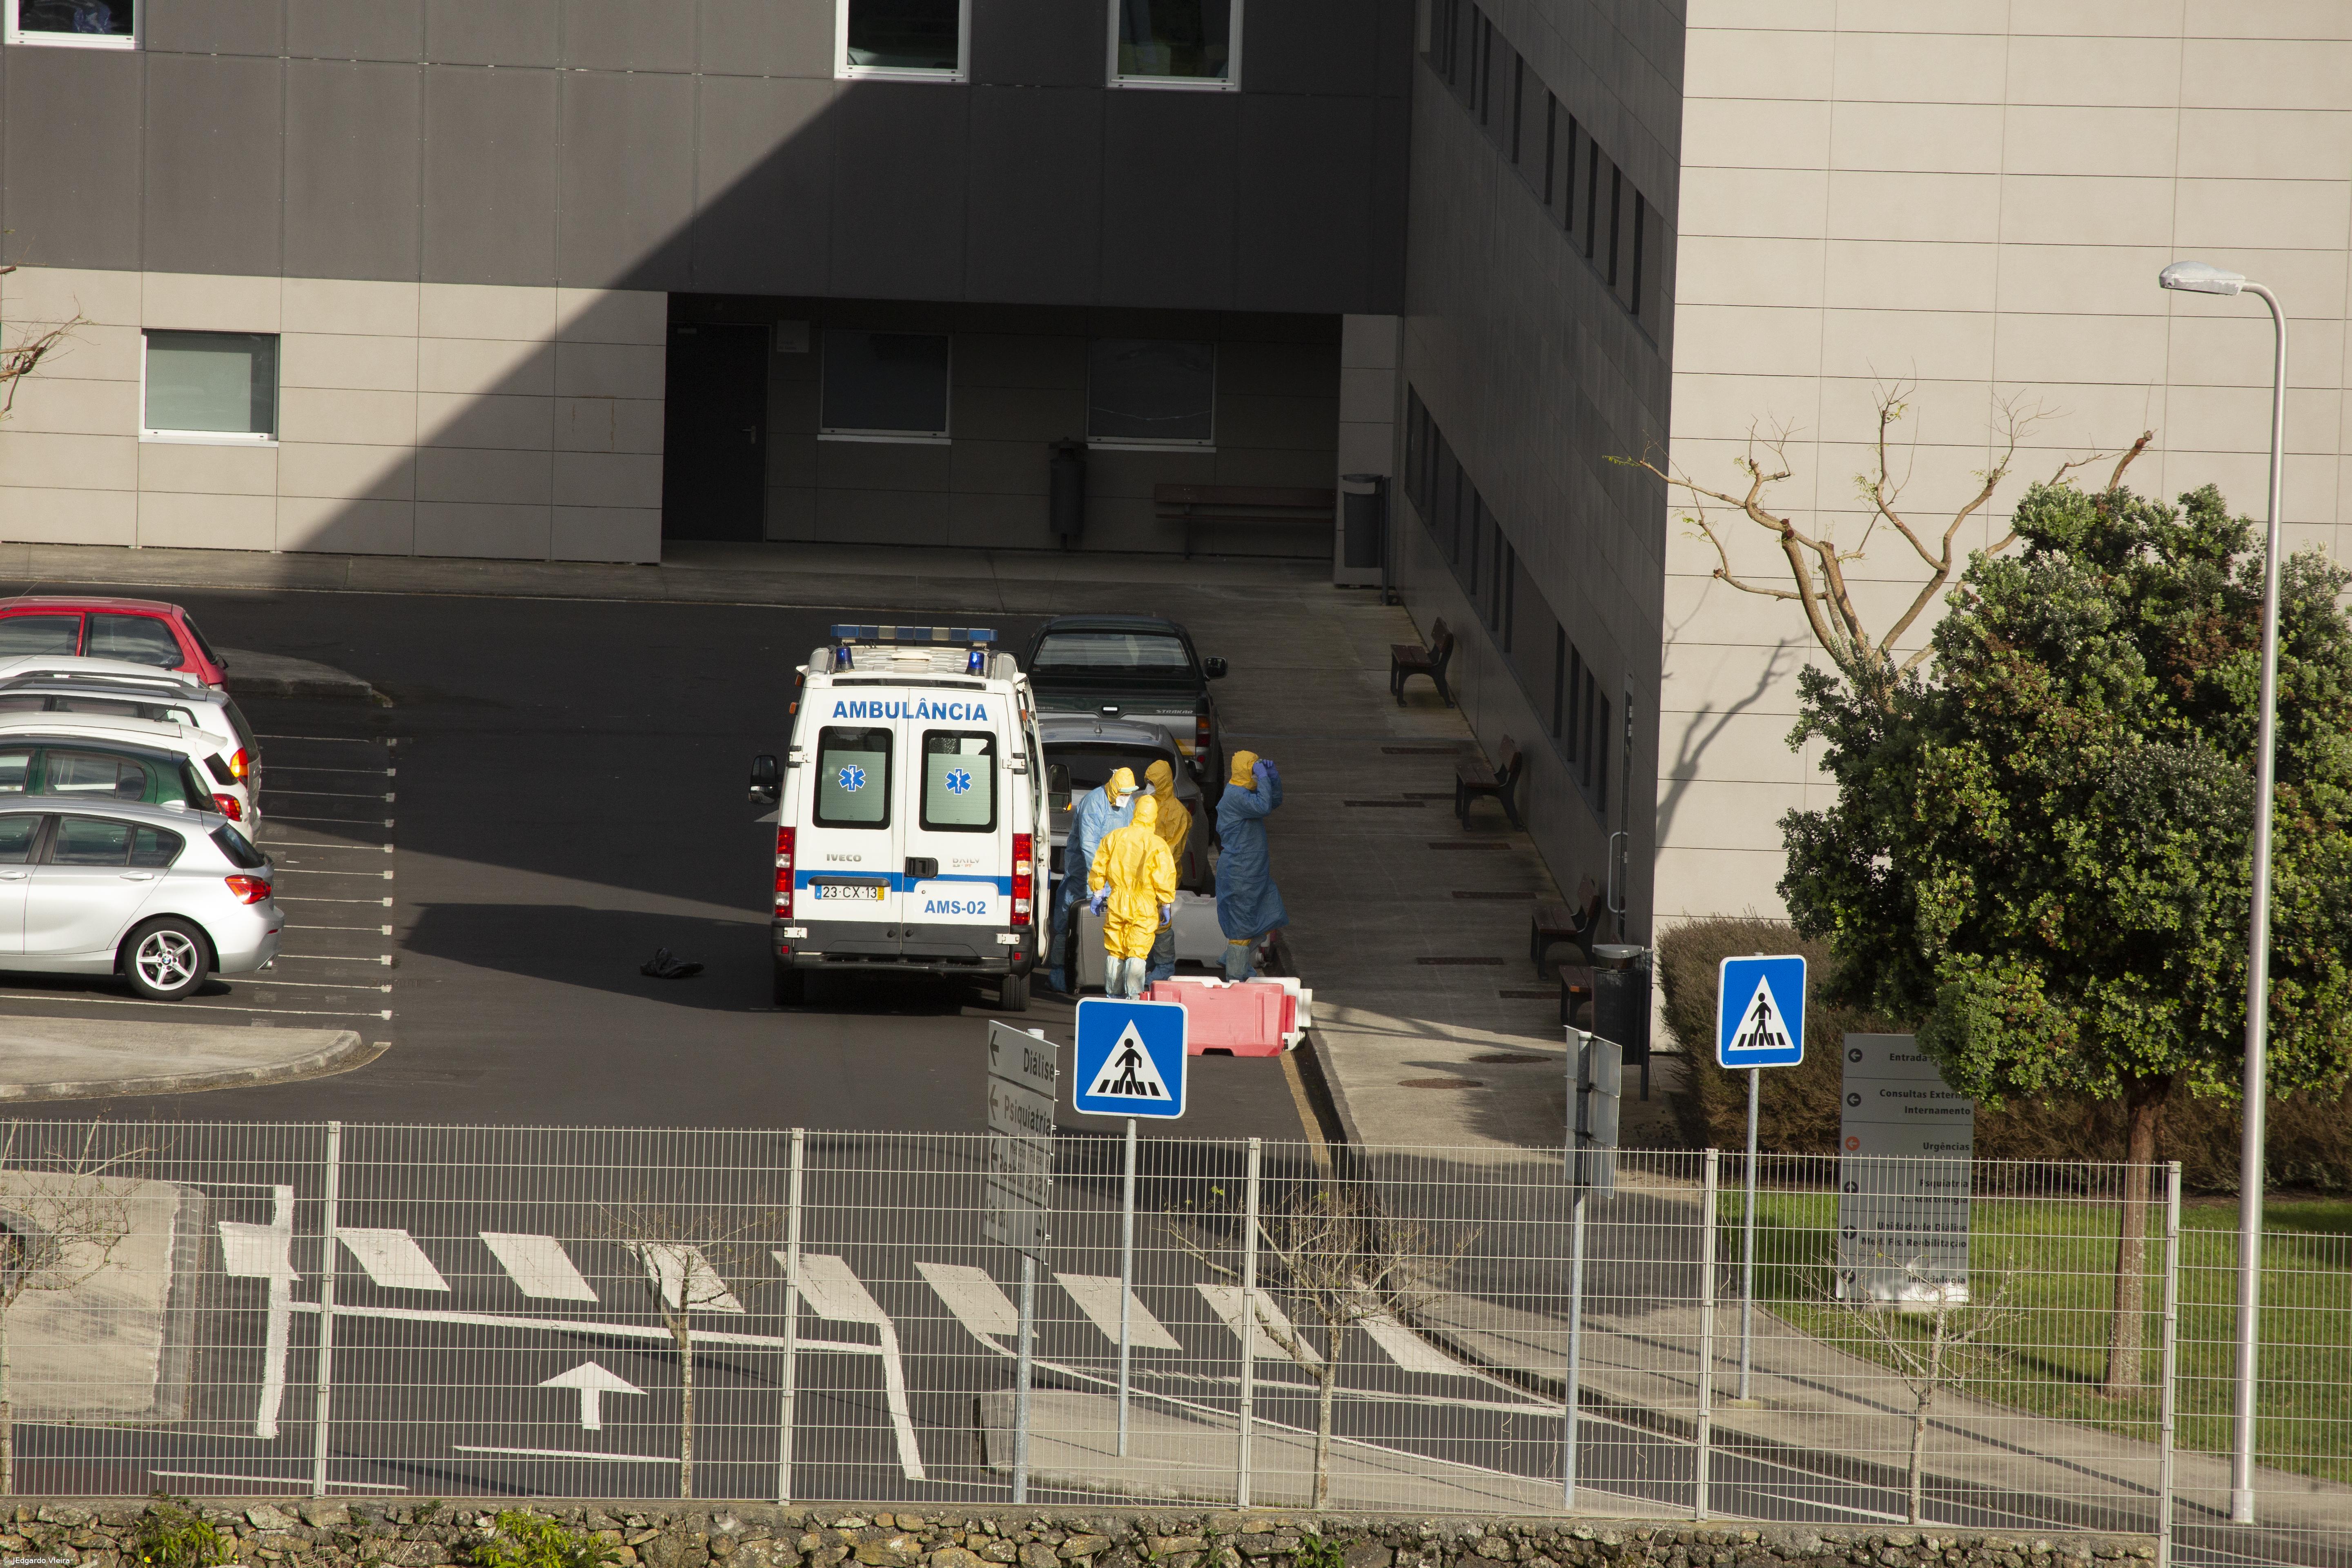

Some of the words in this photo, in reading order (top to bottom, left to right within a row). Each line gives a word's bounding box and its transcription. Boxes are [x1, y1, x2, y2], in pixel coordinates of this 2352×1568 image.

[833, 697, 988, 721] AMBULÂNCIA
[826, 854, 862, 862] IVECO
[924, 900, 986, 914] AMS-02
[1024, 1047, 1054, 1082] Diálise
[1880, 1089, 1927, 1098] Consultas
[1004, 1095, 1051, 1137] Psiquiatria
[1905, 1106, 1970, 1115] Internamento
[1923, 1143, 1970, 1152] Urgências
[1010, 1140, 1028, 1159] Medicin
[1046, 1159, 1049, 1169] e
[985, 1198, 1008, 1229] Sada
[1878, 1222, 1917, 1230] Unidade
[1921, 1223, 1931, 1231] de
[1935, 1223, 1967, 1232] Diálise
[1907, 1238, 1966, 1249] Reabilitação
